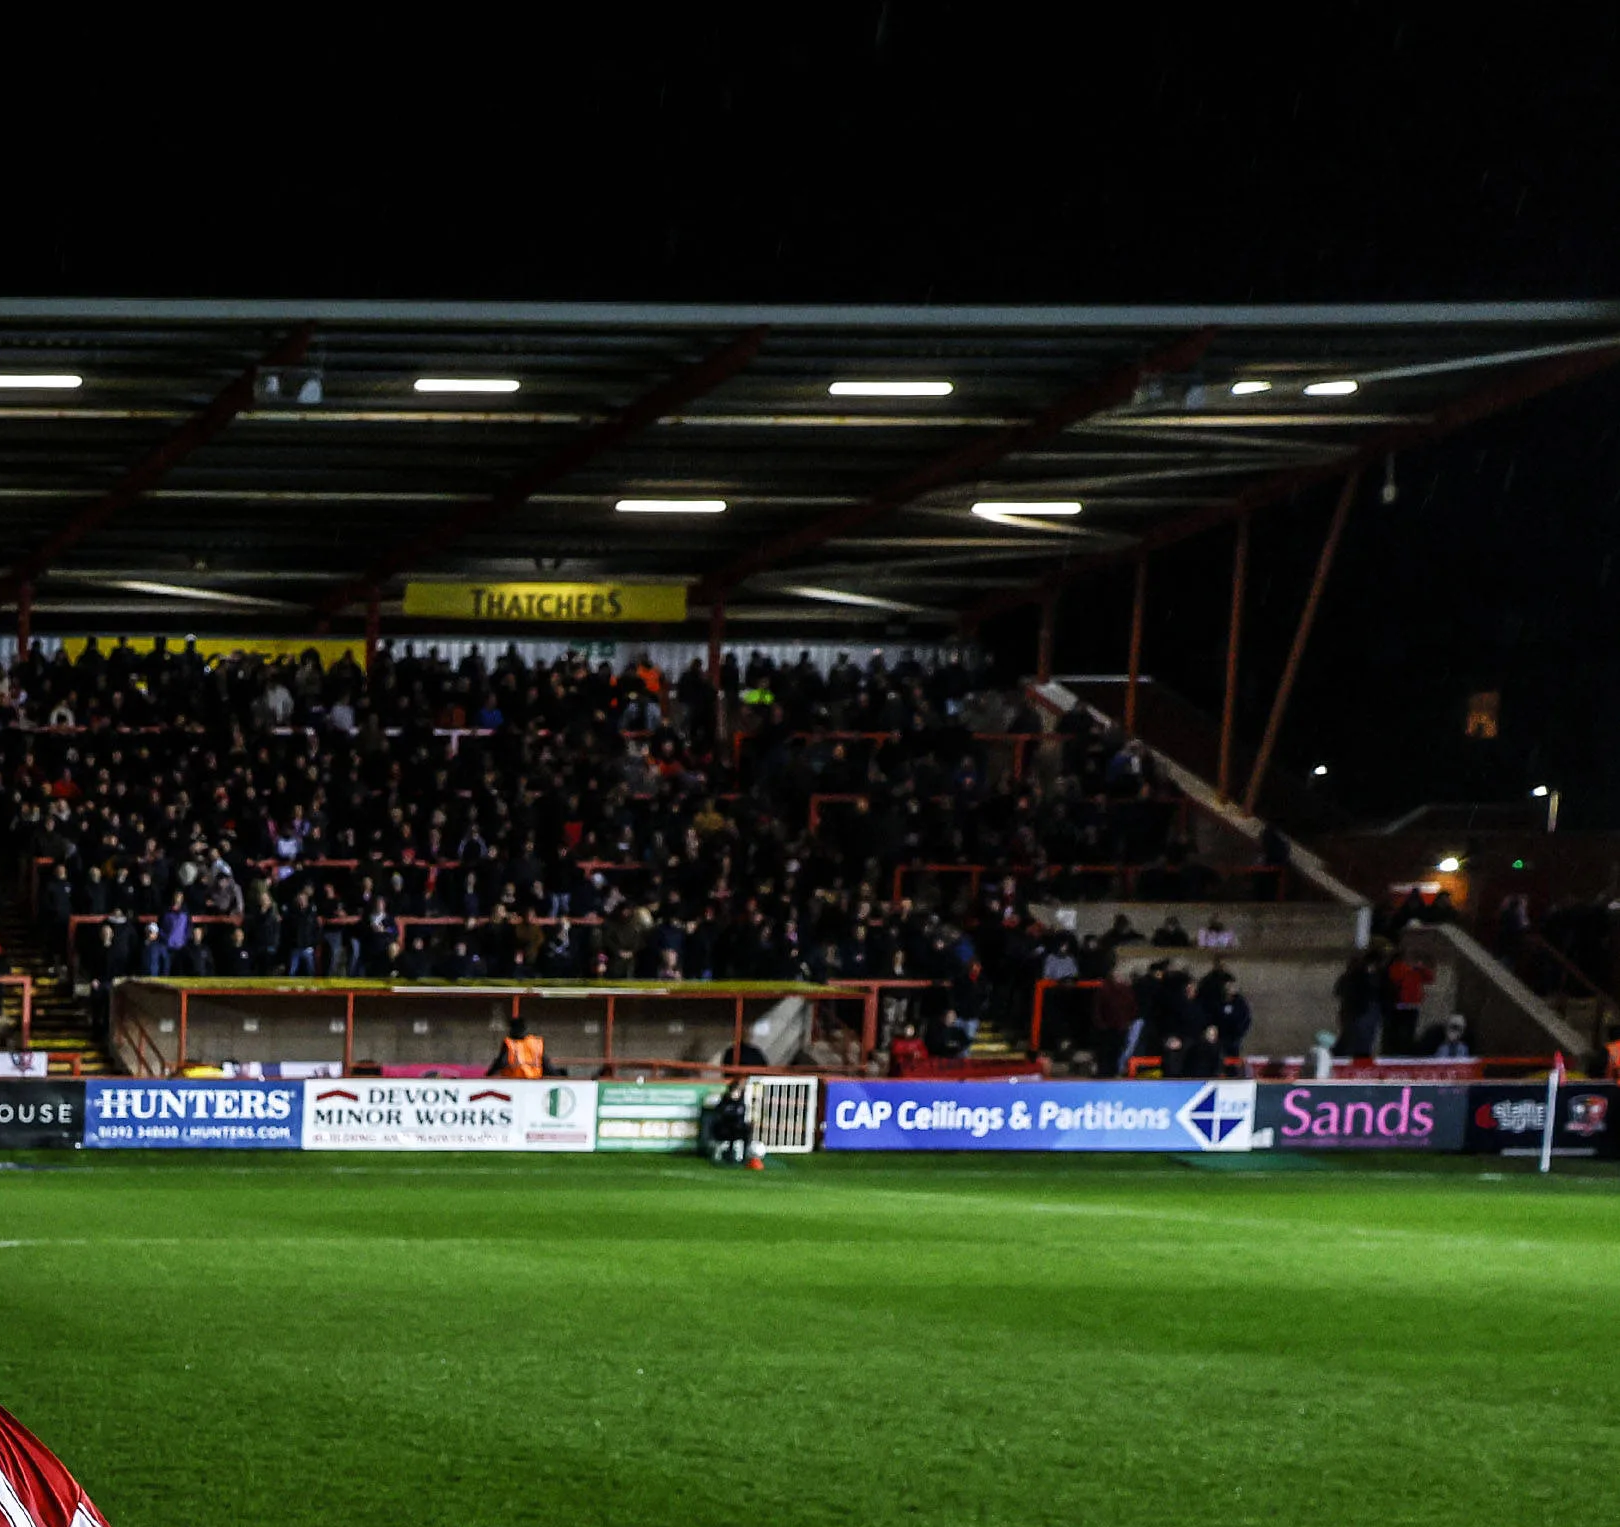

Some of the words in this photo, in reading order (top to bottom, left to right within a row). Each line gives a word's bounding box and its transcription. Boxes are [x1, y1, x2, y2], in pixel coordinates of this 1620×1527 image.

[97, 1088, 292, 1120] HUNTERS
[368, 1088, 461, 1106] DEVON
[1281, 1087, 1435, 1137] Sands
[315, 1108, 402, 1126] MINOR
[415, 1108, 512, 1127] WORKS
[835, 1100, 892, 1131] CAP
[897, 1100, 1005, 1138] Ceilings
[1008, 1100, 1032, 1131] &
[1039, 1101, 1171, 1131] Partitions
